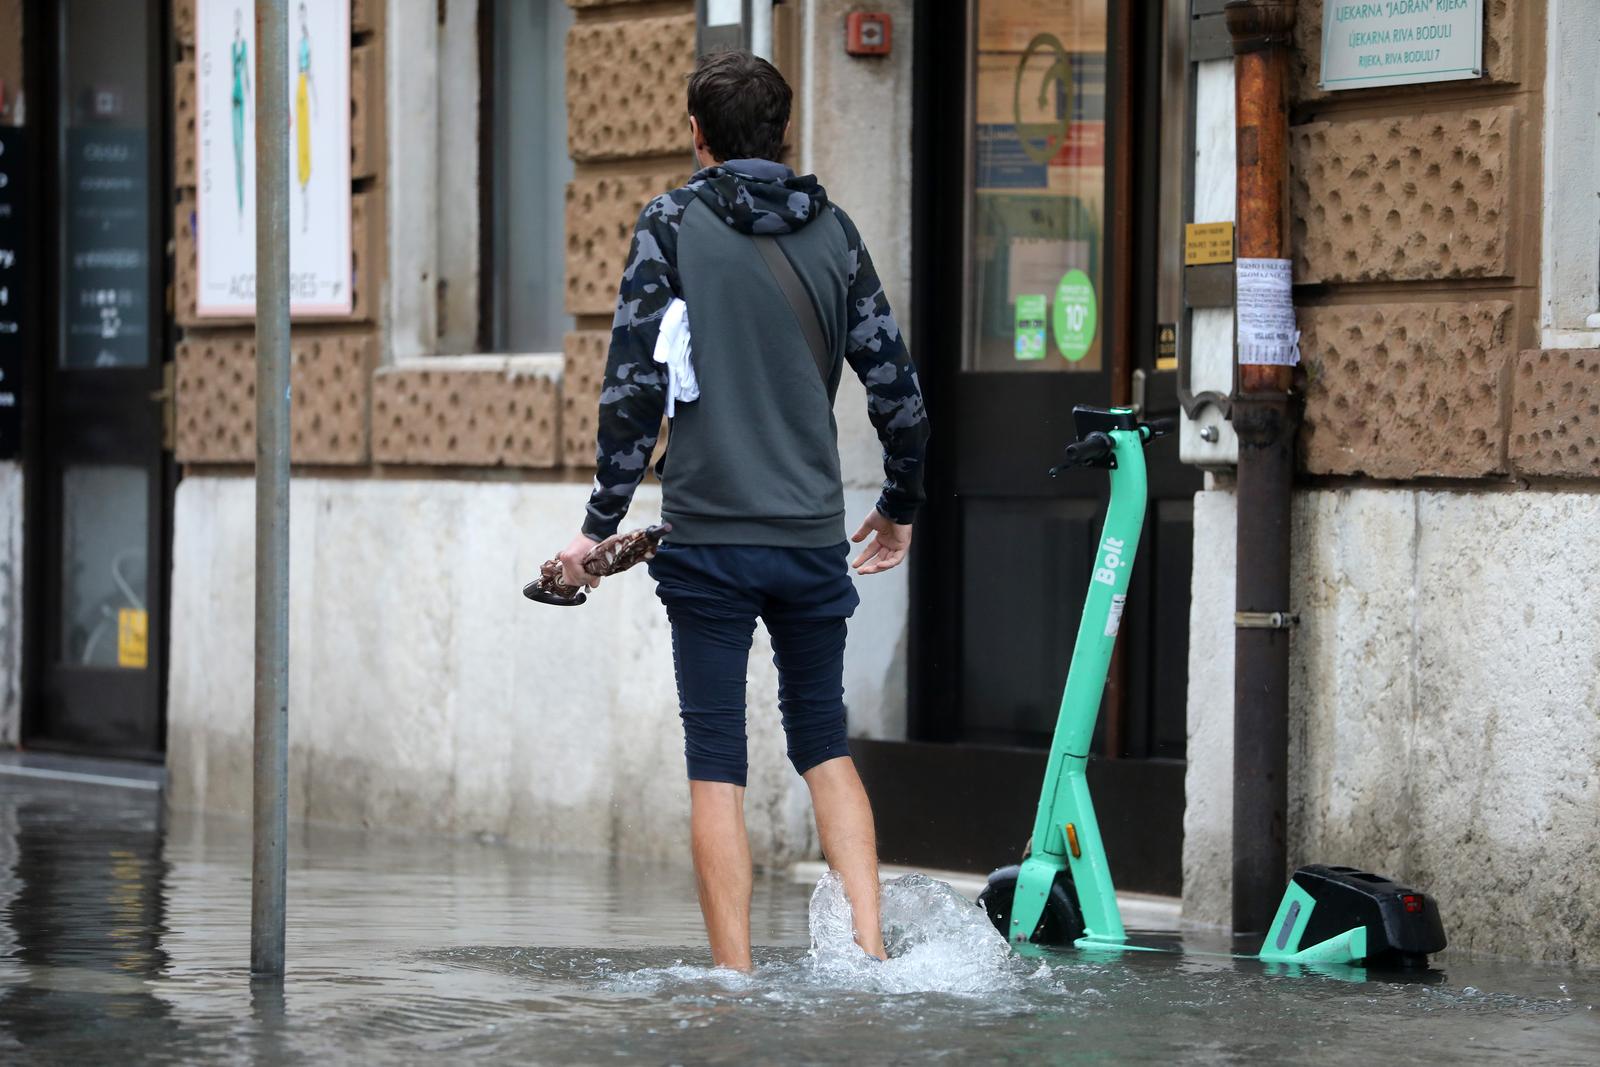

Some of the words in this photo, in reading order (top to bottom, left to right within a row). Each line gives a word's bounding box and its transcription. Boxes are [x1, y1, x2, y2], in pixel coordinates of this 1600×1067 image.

[1336, 3, 1383, 23] LJEKARNA
[1436, 0, 1468, 12] RIJEKA
[1348, 31, 1390, 48] LJEKARNA
[1392, 28, 1413, 43] RIVA
[1416, 24, 1452, 40] BODULI
[1385, 52, 1402, 65] RIVA
[1404, 50, 1433, 63] BODULI
[1095, 537, 1126, 586] Bolt
